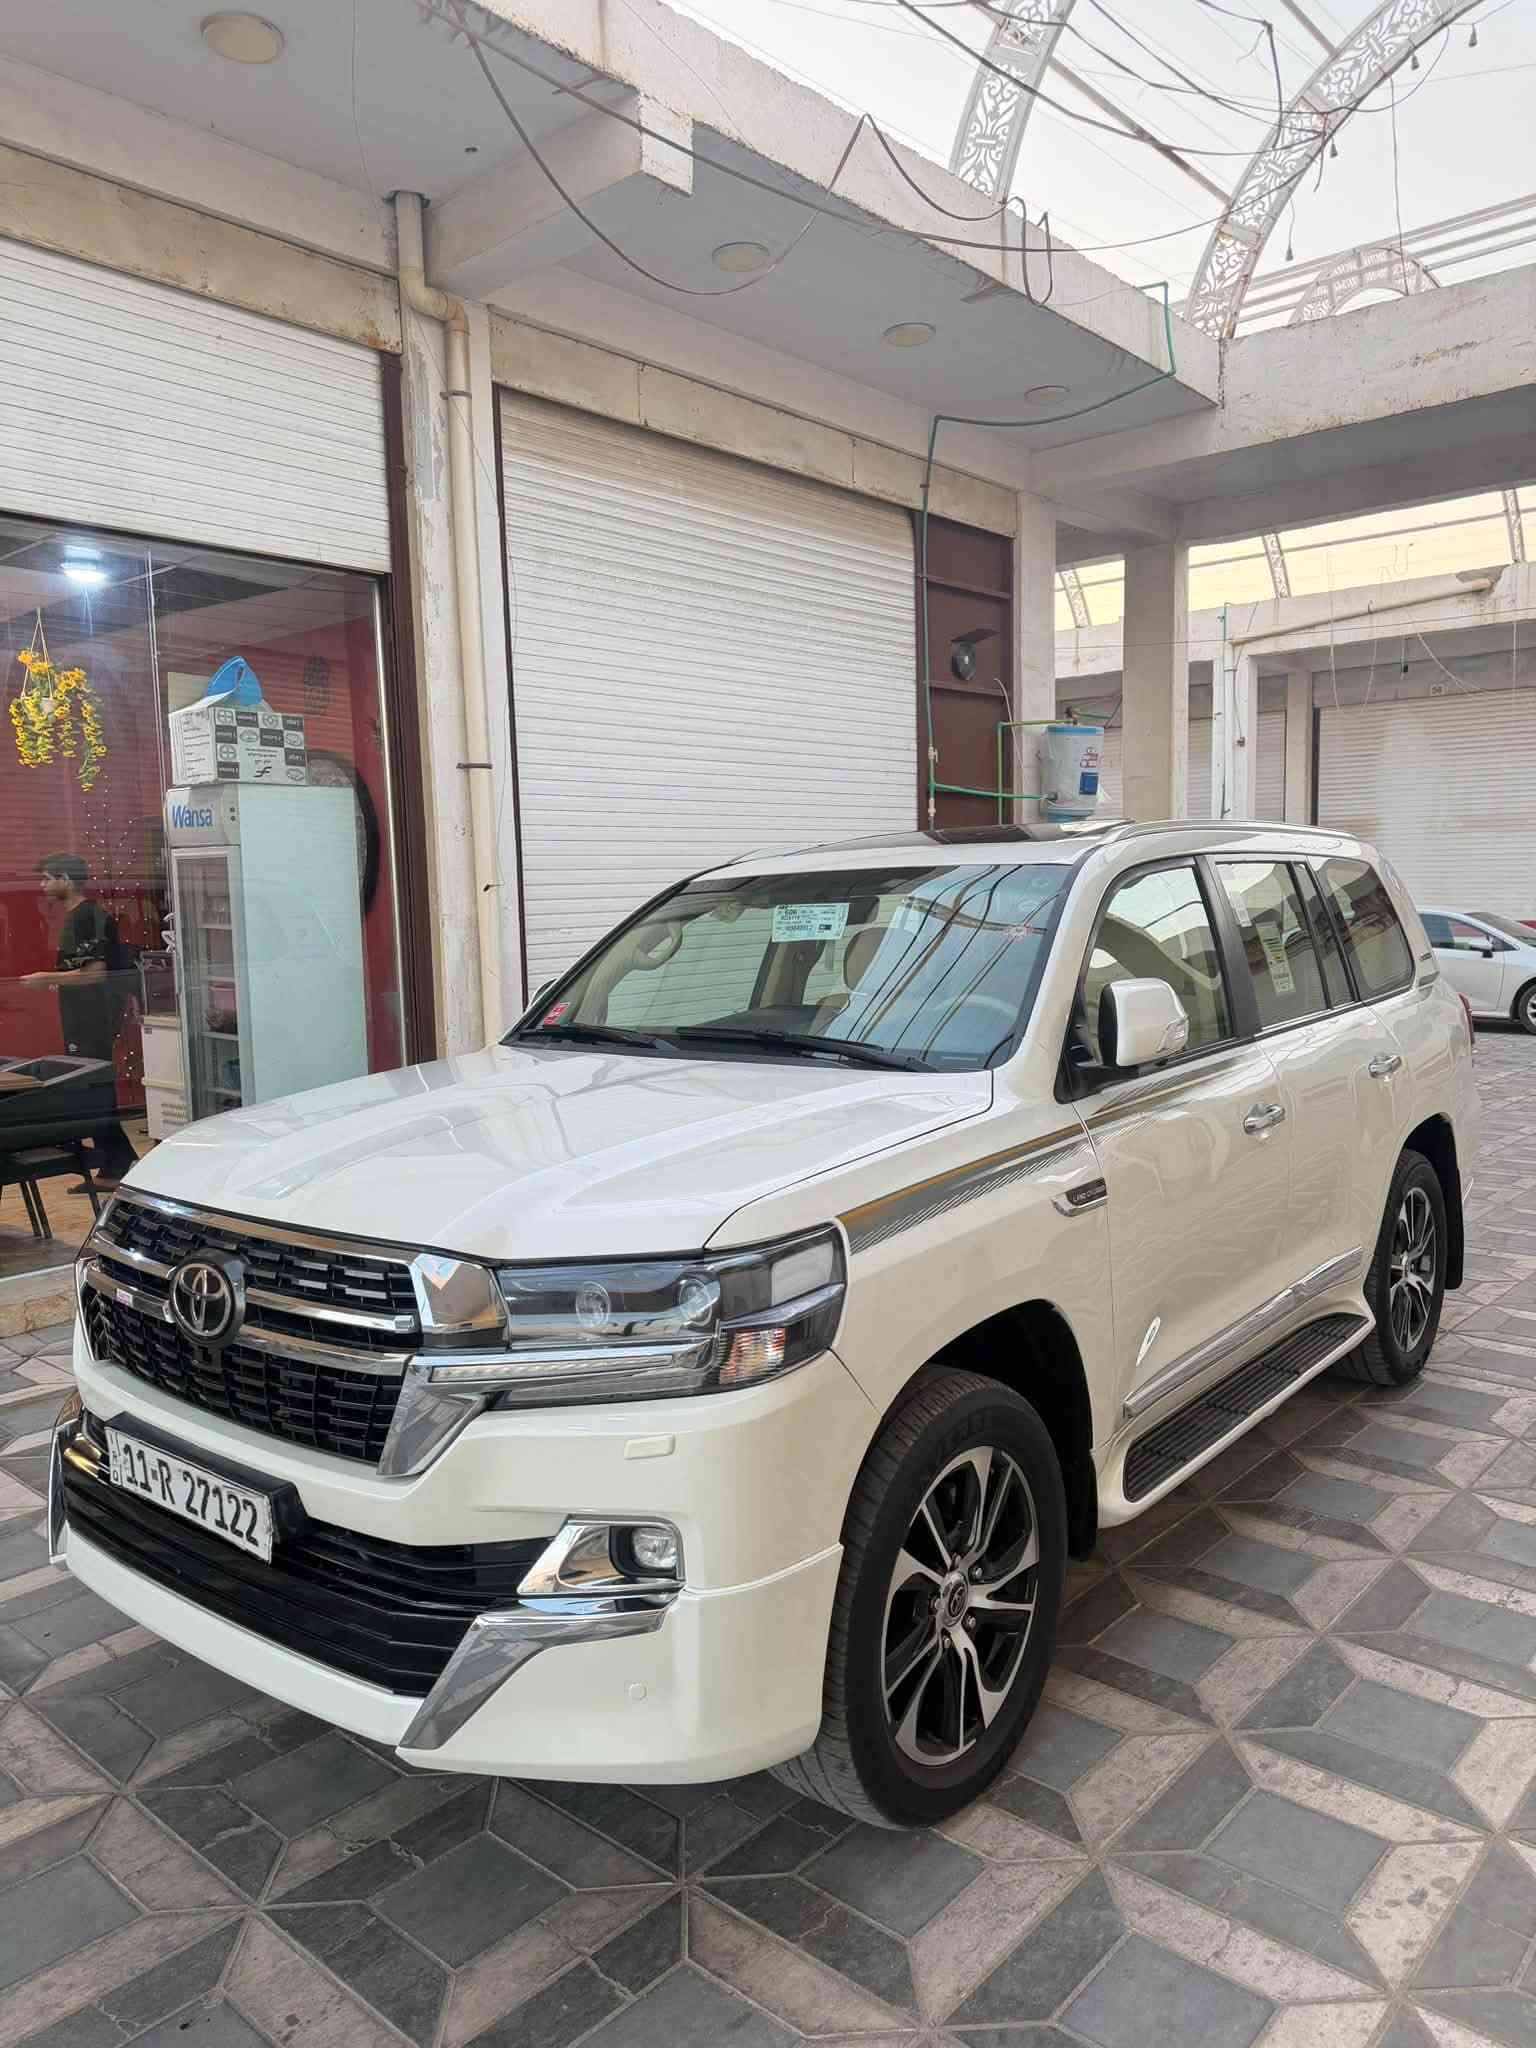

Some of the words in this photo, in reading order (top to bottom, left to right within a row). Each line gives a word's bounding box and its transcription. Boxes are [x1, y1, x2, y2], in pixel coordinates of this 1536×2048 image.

[172, 805, 212, 828] Wansa
[123, 1443, 176, 1505] 11-R
[183, 1470, 259, 1547] 27122
